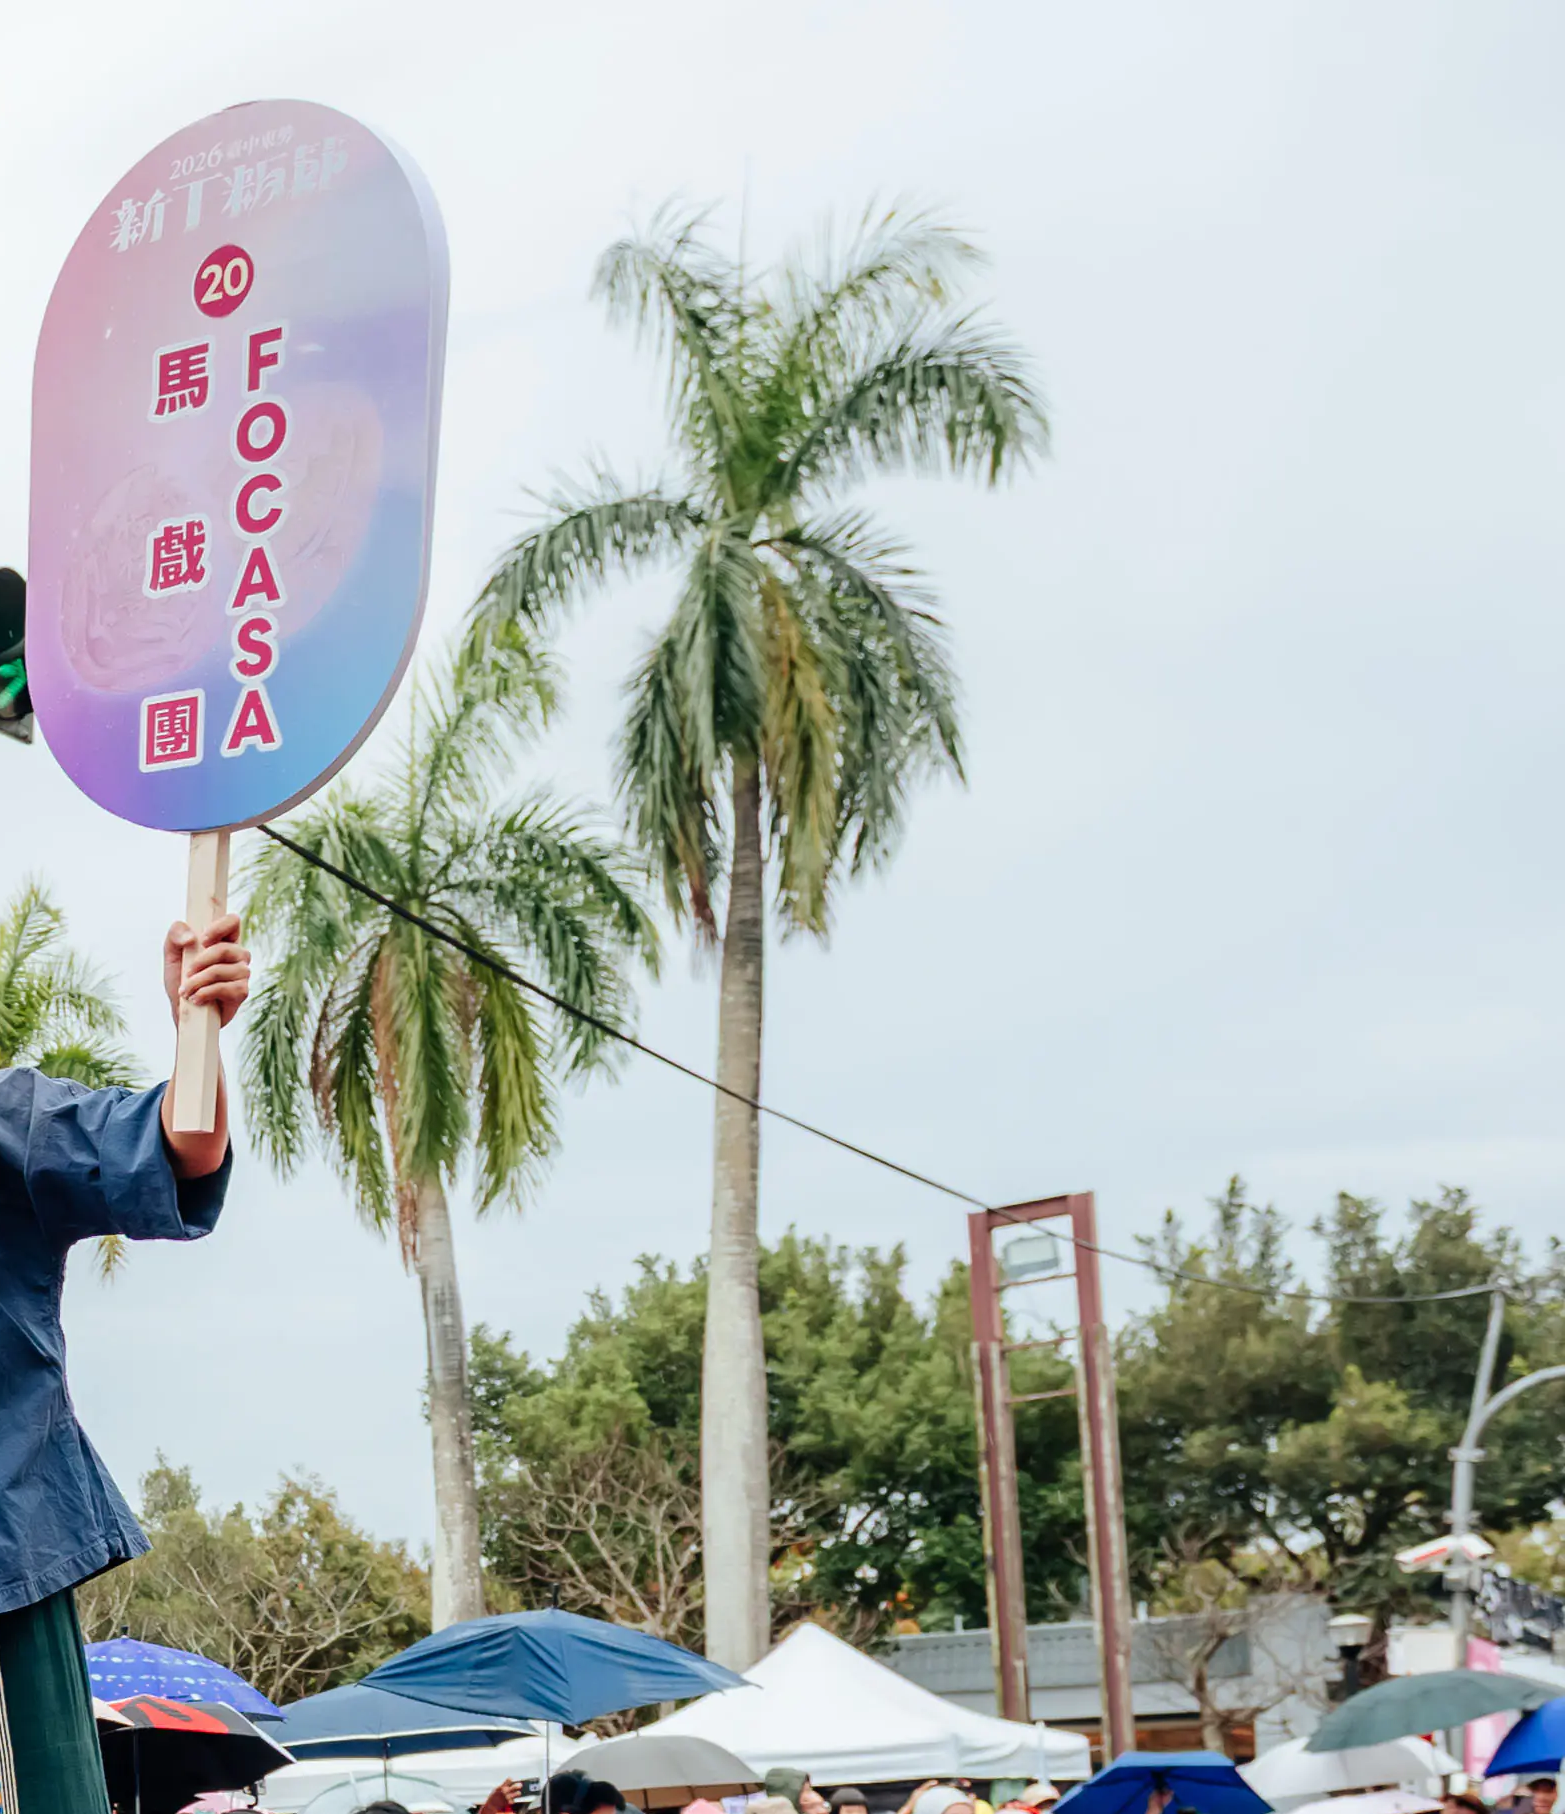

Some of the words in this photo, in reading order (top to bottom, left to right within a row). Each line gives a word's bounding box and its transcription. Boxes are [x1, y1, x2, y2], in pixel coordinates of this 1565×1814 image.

[169, 141, 223, 180] 2026
[200, 257, 249, 305] 20
[146, 342, 210, 766] 馬戲團
[226, 326, 287, 751] FOCASA
